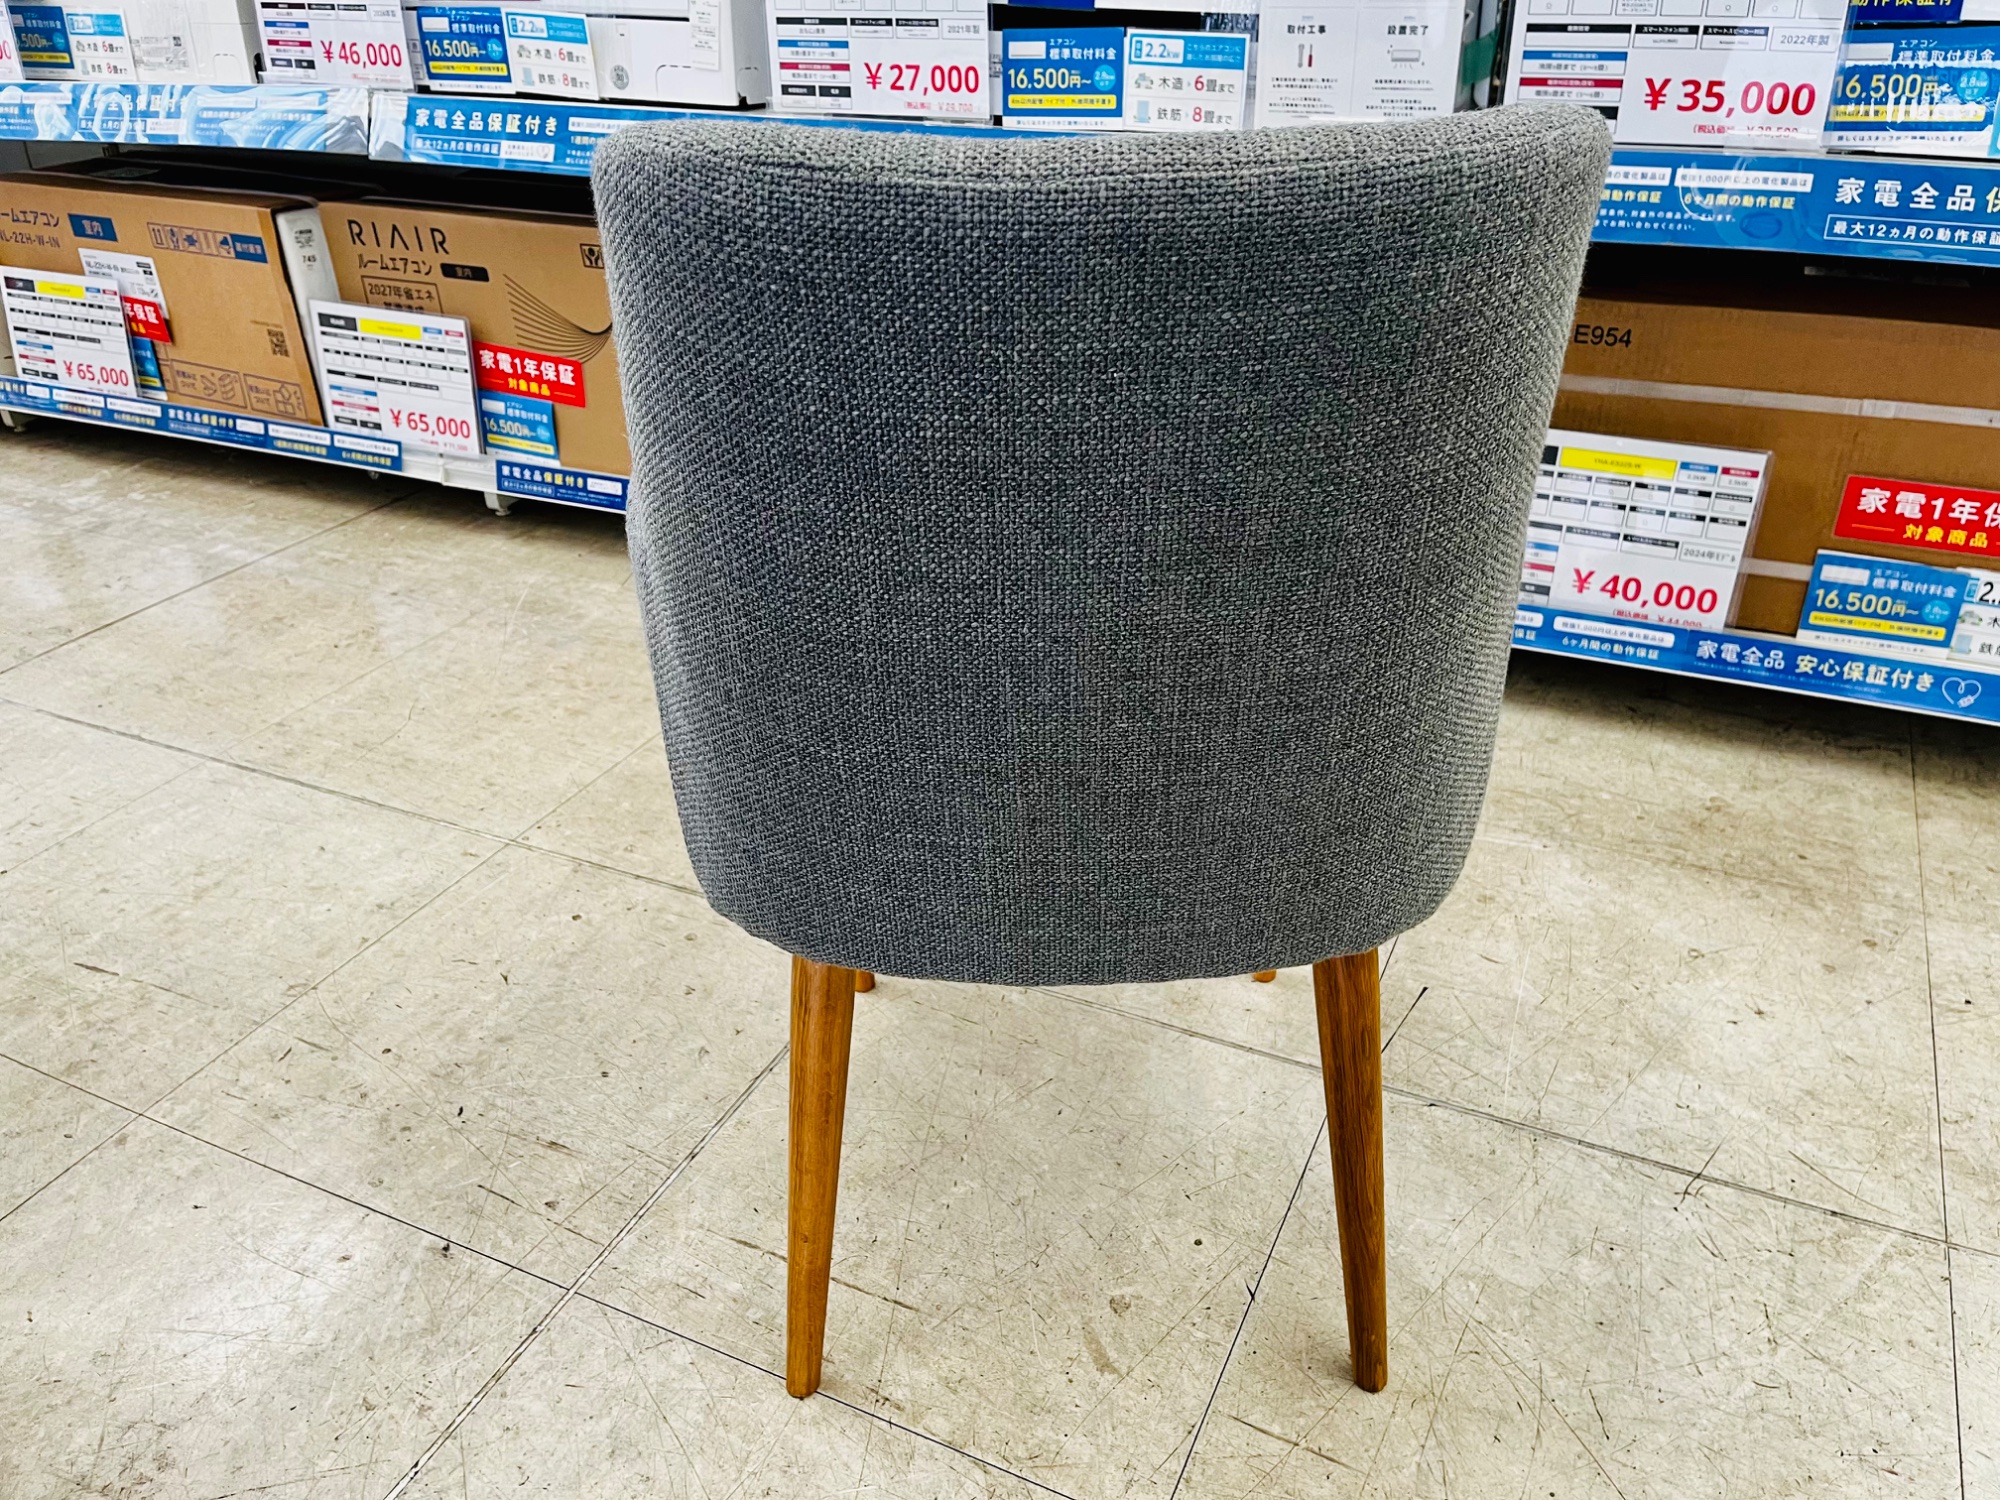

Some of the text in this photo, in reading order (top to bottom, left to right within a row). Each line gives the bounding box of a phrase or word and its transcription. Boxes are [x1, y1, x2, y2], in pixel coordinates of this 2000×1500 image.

[1779, 34, 1831, 46] 2022年製
[1899, 39, 1938, 48] エアコン
[1049, 47, 1117, 61] 標準取付料金
[1158, 75, 1236, 94] 木造 6畳まで
[415, 107, 559, 137] 家電全品保証付き
[1157, 106, 1234, 125] 鉄筋 8畳まで
[358, 253, 433, 277] ルームエアコン
[1573, 323, 1633, 348] E954
[479, 349, 577, 387] 家電1年保証
[1902, 523, 1989, 549] 対象商品
[1571, 567, 1719, 615] ¥40,000
[1696, 640, 1786, 670] 家電全品
[1795, 654, 1936, 693] 安心保証付き
